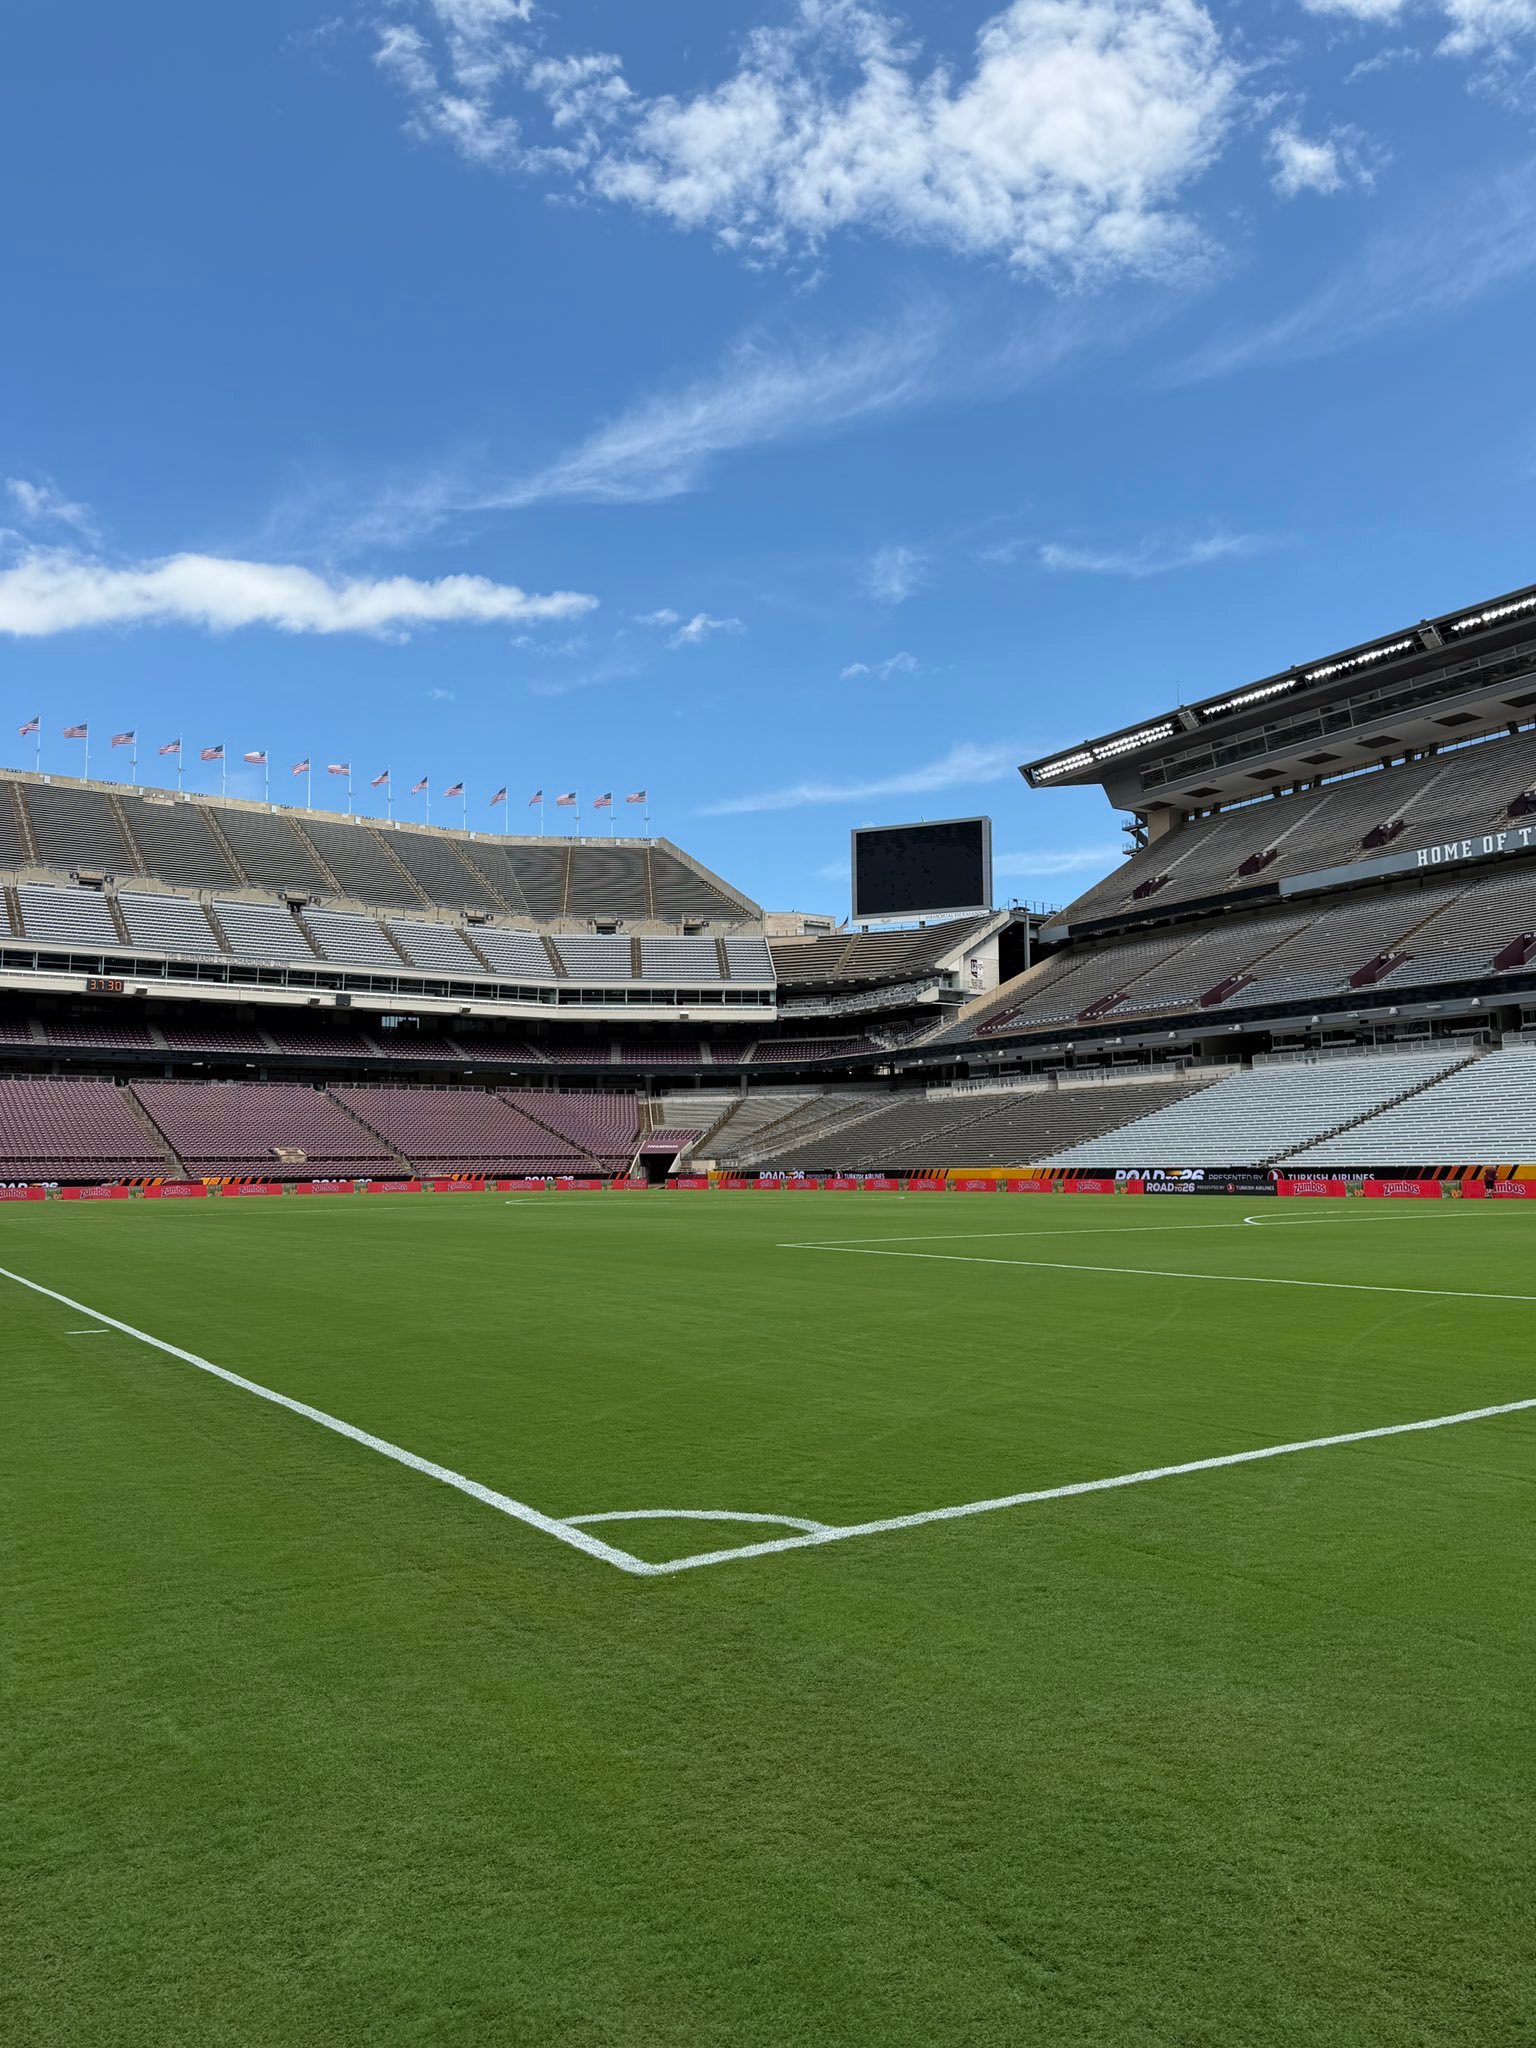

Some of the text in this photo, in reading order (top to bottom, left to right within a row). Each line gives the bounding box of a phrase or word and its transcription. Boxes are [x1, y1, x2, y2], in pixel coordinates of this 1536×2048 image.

[1416, 827, 1536, 867] HOME OF T
[1146, 1183, 1174, 1192] ROAD
[1182, 1183, 1195, 1192] 26
